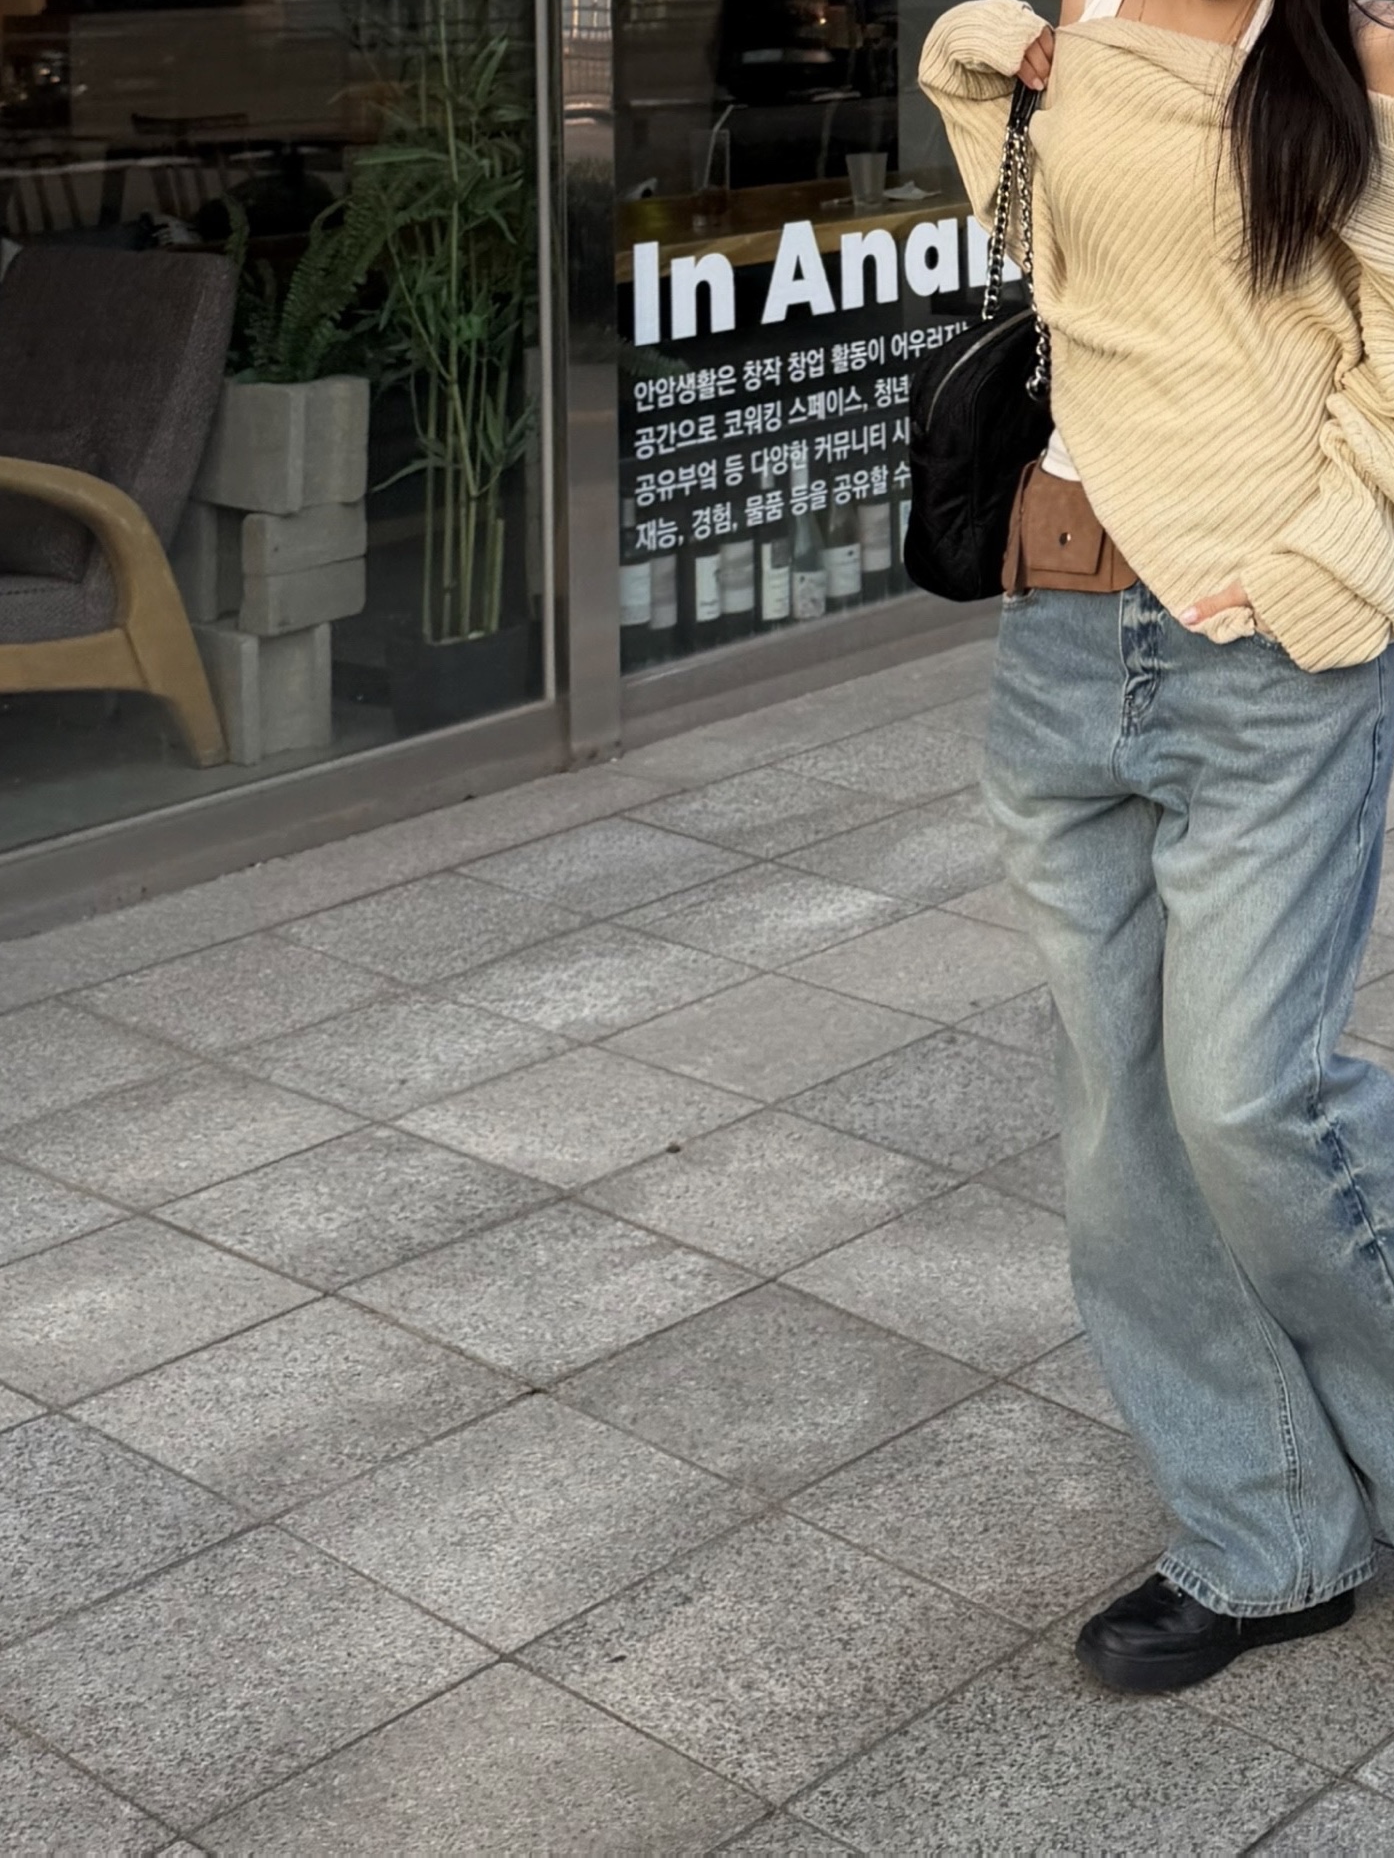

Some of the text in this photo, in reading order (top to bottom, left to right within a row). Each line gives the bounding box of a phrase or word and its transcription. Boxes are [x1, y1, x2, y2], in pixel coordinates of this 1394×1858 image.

[633, 241, 736, 347] In
[634, 364, 737, 413] 안암생활은
[743, 355, 782, 392] 창작
[787, 347, 825, 383] 창업
[831, 335, 885, 375] 활동이
[634, 414, 718, 460] 공간으로
[723, 399, 783, 439] 코워킹
[788, 385, 869, 425] 스페이스,
[634, 458, 717, 507] 공유부엌
[724, 453, 745, 487] 등
[751, 438, 809, 477] 다양한
[814, 421, 886, 464] 커뮤니티
[635, 460, 912, 551] 재능, 경험, 물품 등을 공유할 수
